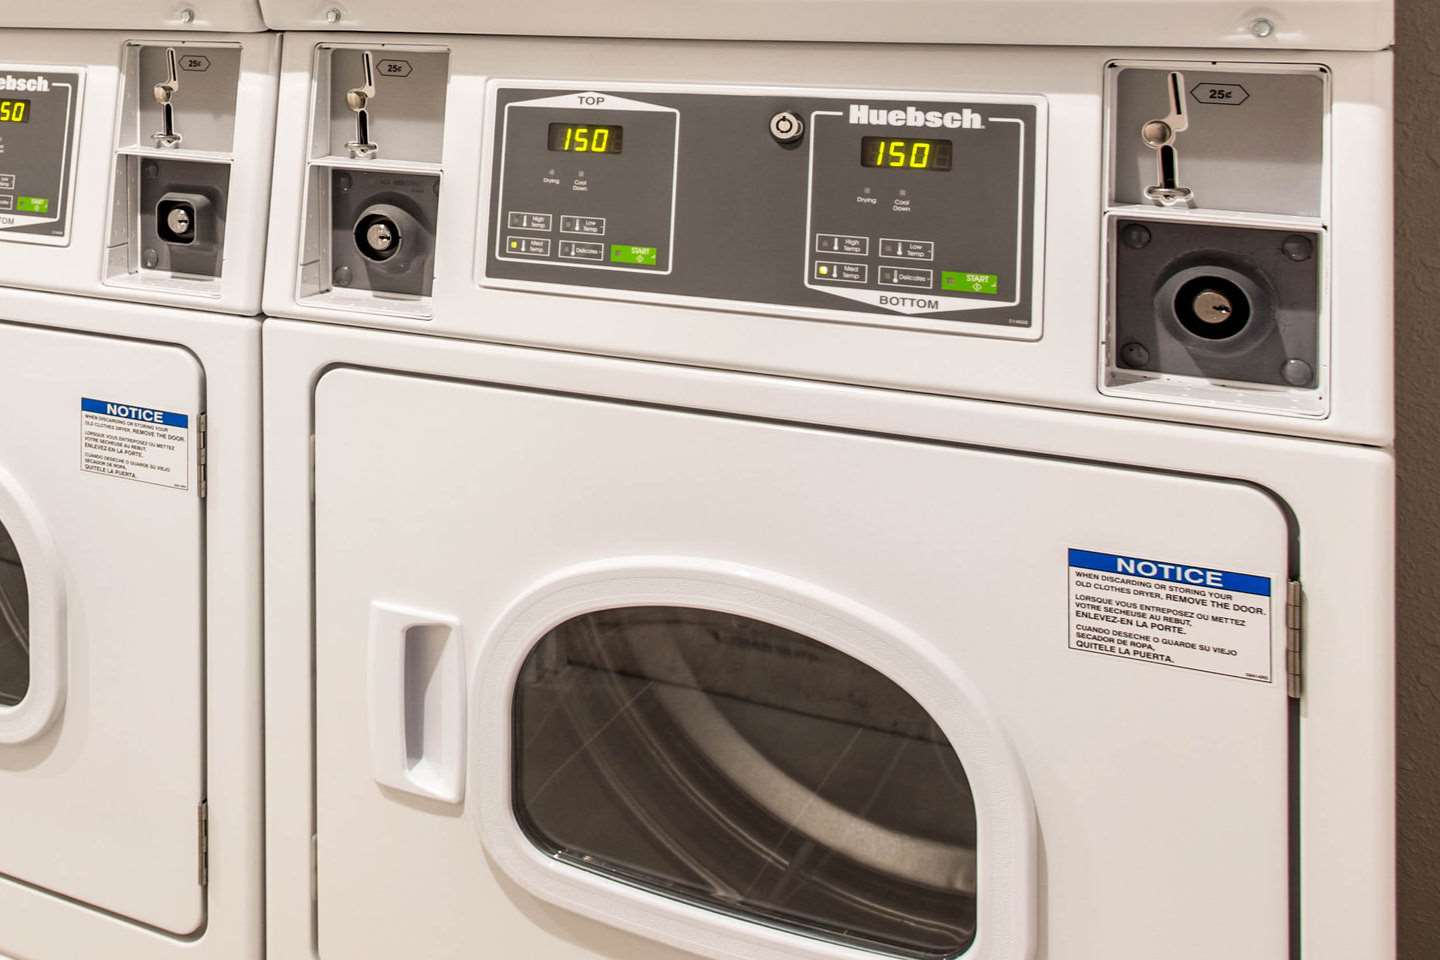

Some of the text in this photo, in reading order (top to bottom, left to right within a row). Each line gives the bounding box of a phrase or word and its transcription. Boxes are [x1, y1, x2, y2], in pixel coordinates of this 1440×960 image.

[386, 63, 402, 73] 25¢
[577, 95, 605, 106] TOP
[1209, 88, 1233, 100] 25¢
[849, 104, 982, 129] Huebsch
[562, 127, 609, 153] 150
[876, 141, 930, 169] 150
[966, 273, 990, 282] START
[879, 295, 939, 310] BOTTOM
[106, 403, 164, 424] NOTICE
[1116, 557, 1224, 587] NOTICE
[1075, 571, 1233, 601] WHEN DISCARDING OR STORING YOUR
[1075, 580, 1092, 588] OLD
[1093, 583, 1131, 594] CLOTHES
[1165, 593, 1208, 607] REMOVE
[1210, 600, 1230, 610] THE
[1232, 604, 1267, 615] DOOR.
[1075, 594, 1247, 627] LORSQUE VOUS ENTREPOSEZ OU METTEZ
[1075, 602, 1101, 612] VOTRE
[1103, 606, 1147, 619] SECHEUSE
[1075, 610, 1187, 635] ENLEVEZ-EN LA PORTE.
[1075, 624, 1111, 635] CUANDO
[1112, 630, 1151, 642] DESECHE
[1161, 638, 1197, 650] GUARDE
[1198, 644, 1210, 652] SU
[1212, 646, 1238, 656] VIEJO
[1076, 631, 1115, 644] SECADOR
[1116, 638, 1129, 646] DE
[1076, 640, 1175, 663] QUITELE LA PUERTA.
